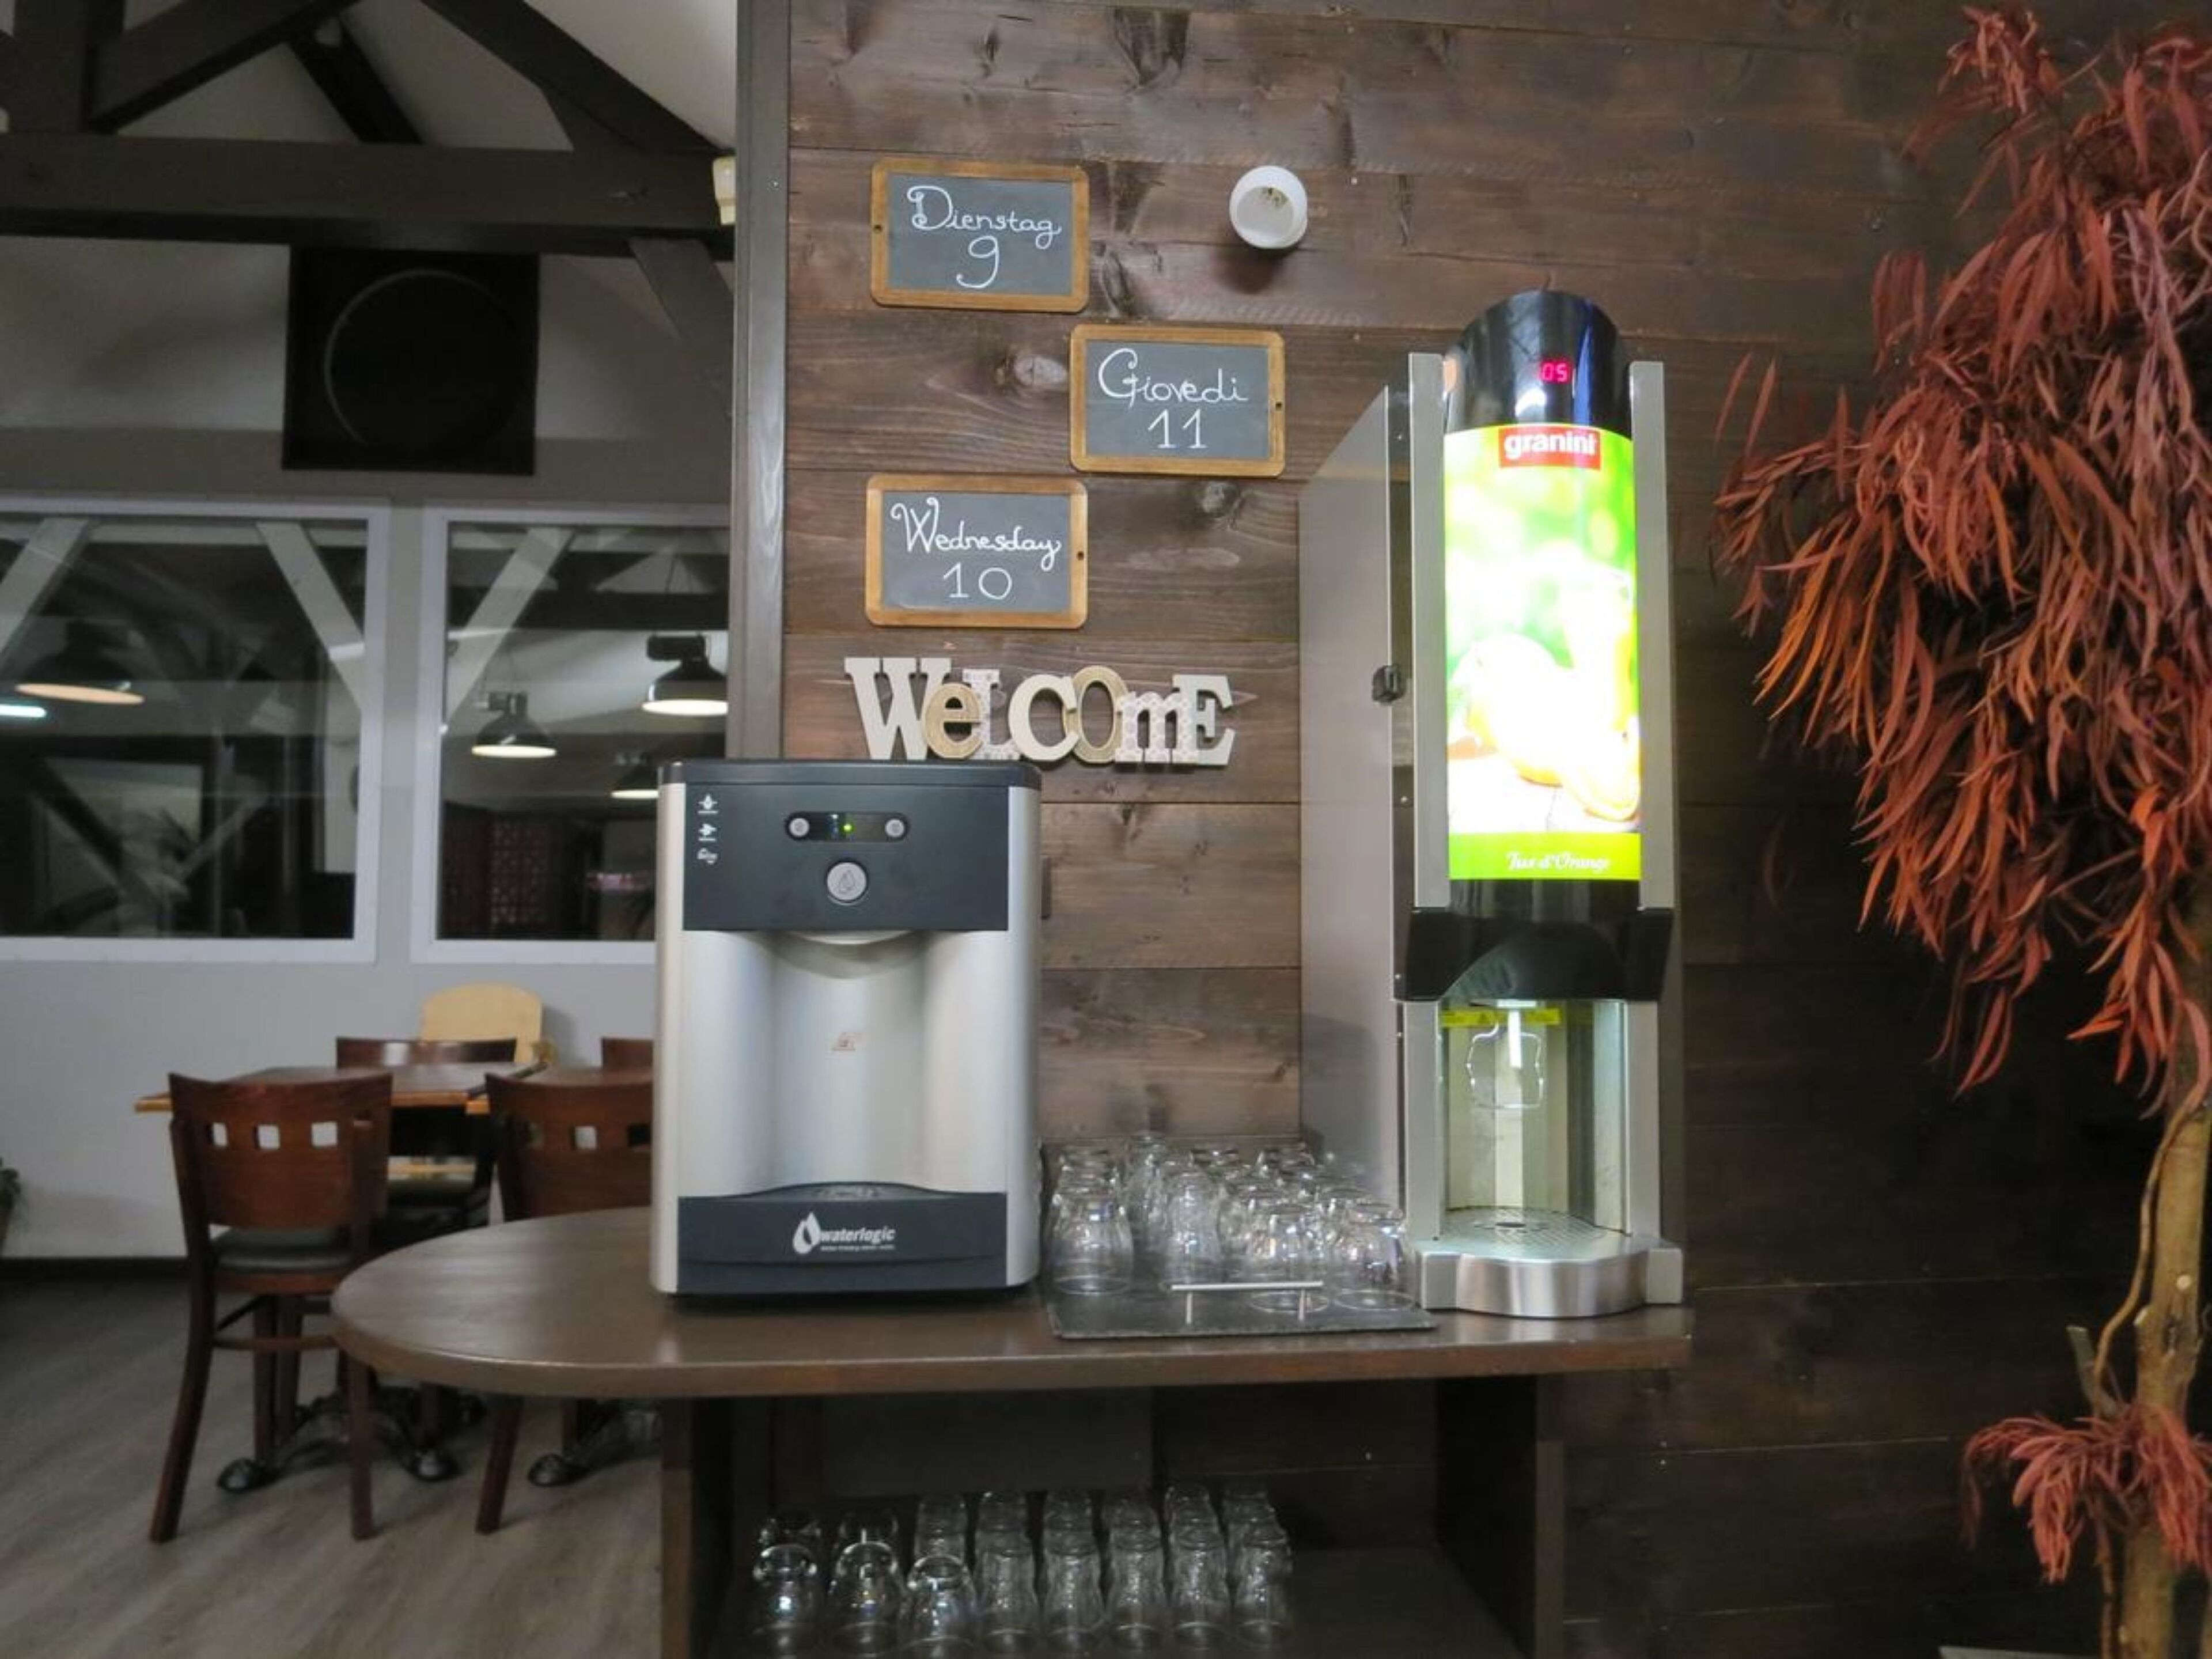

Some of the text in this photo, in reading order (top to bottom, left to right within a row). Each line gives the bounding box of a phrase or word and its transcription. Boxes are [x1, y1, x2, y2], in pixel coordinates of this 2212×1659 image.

[907, 185, 1062, 249] Dienstag
[956, 235, 999, 288] 9
[1098, 348, 1248, 408] Giovedi
[1148, 409, 1207, 449] 11
[1503, 431, 1597, 459] granini
[891, 497, 1061, 571] Wednesday
[943, 562, 1012, 600] 10
[820, 1226, 896, 1245] waterlogic
